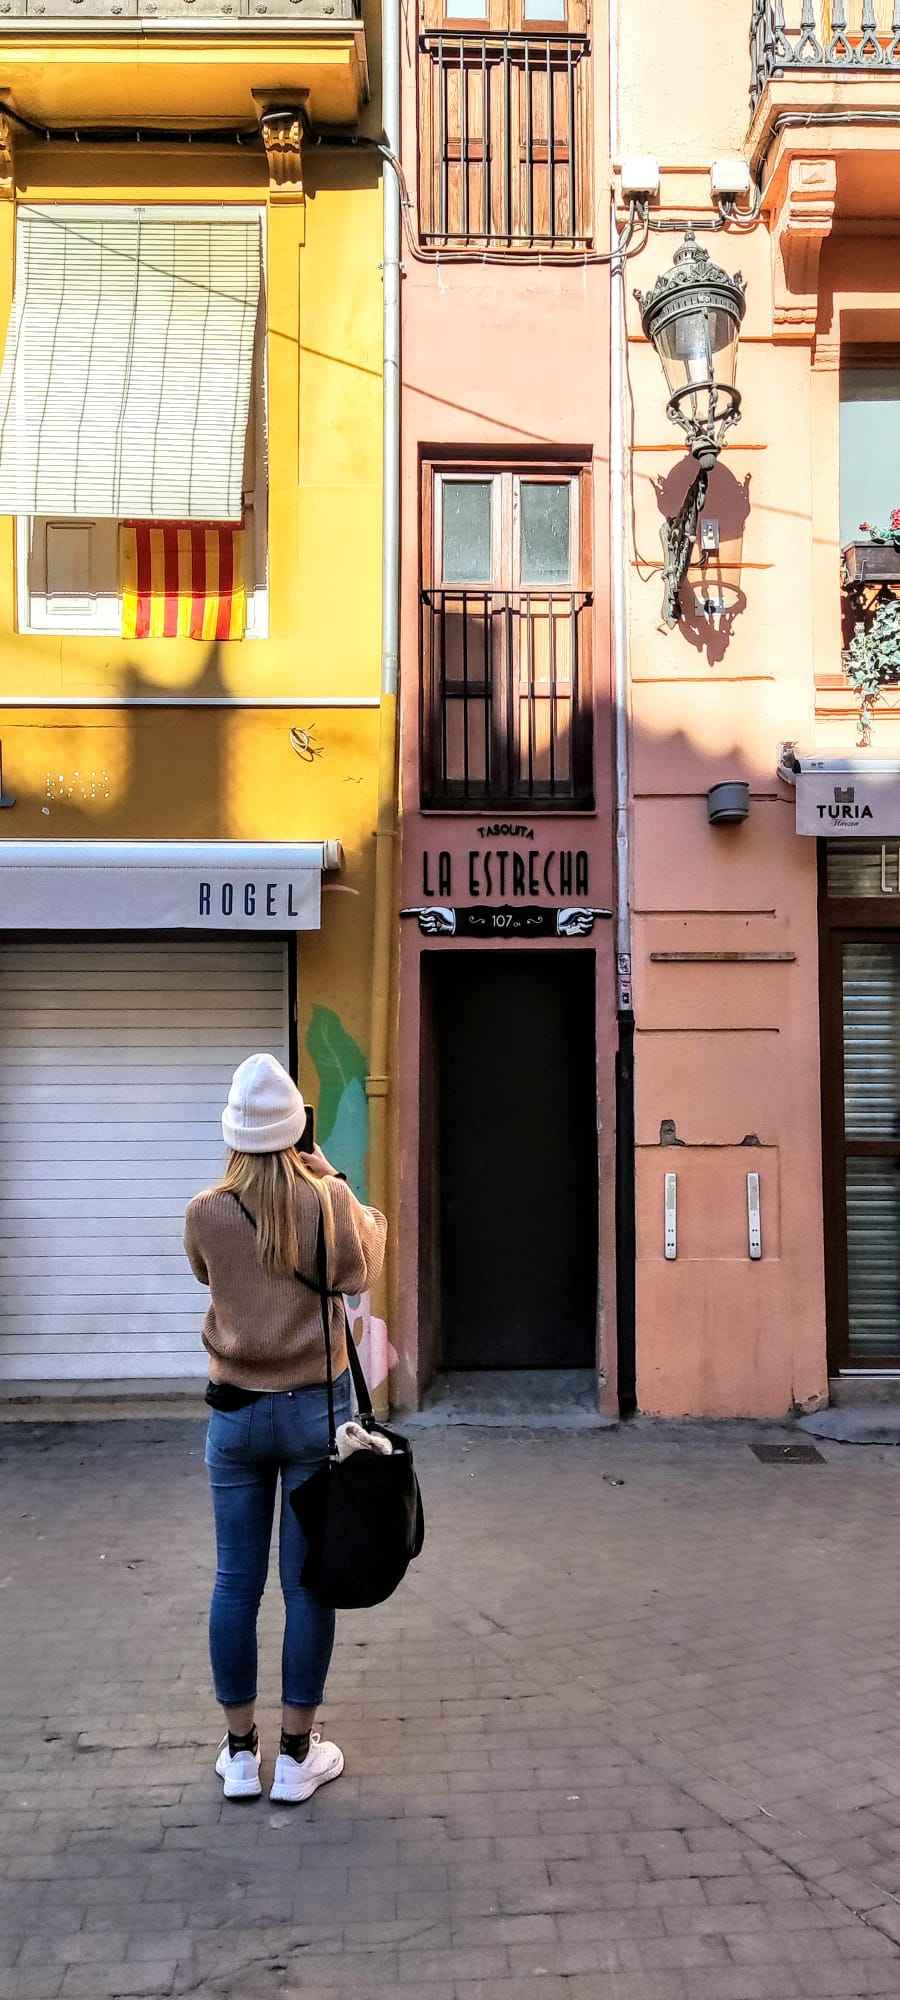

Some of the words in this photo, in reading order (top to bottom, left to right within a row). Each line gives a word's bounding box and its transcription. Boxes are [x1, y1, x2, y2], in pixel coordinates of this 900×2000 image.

[816, 804, 873, 819] TURIA
[423, 850, 451, 897] LA
[468, 850, 589, 897] ESTRECHA
[199, 882, 299, 917] ROGEL
[491, 914, 513, 928] 107
